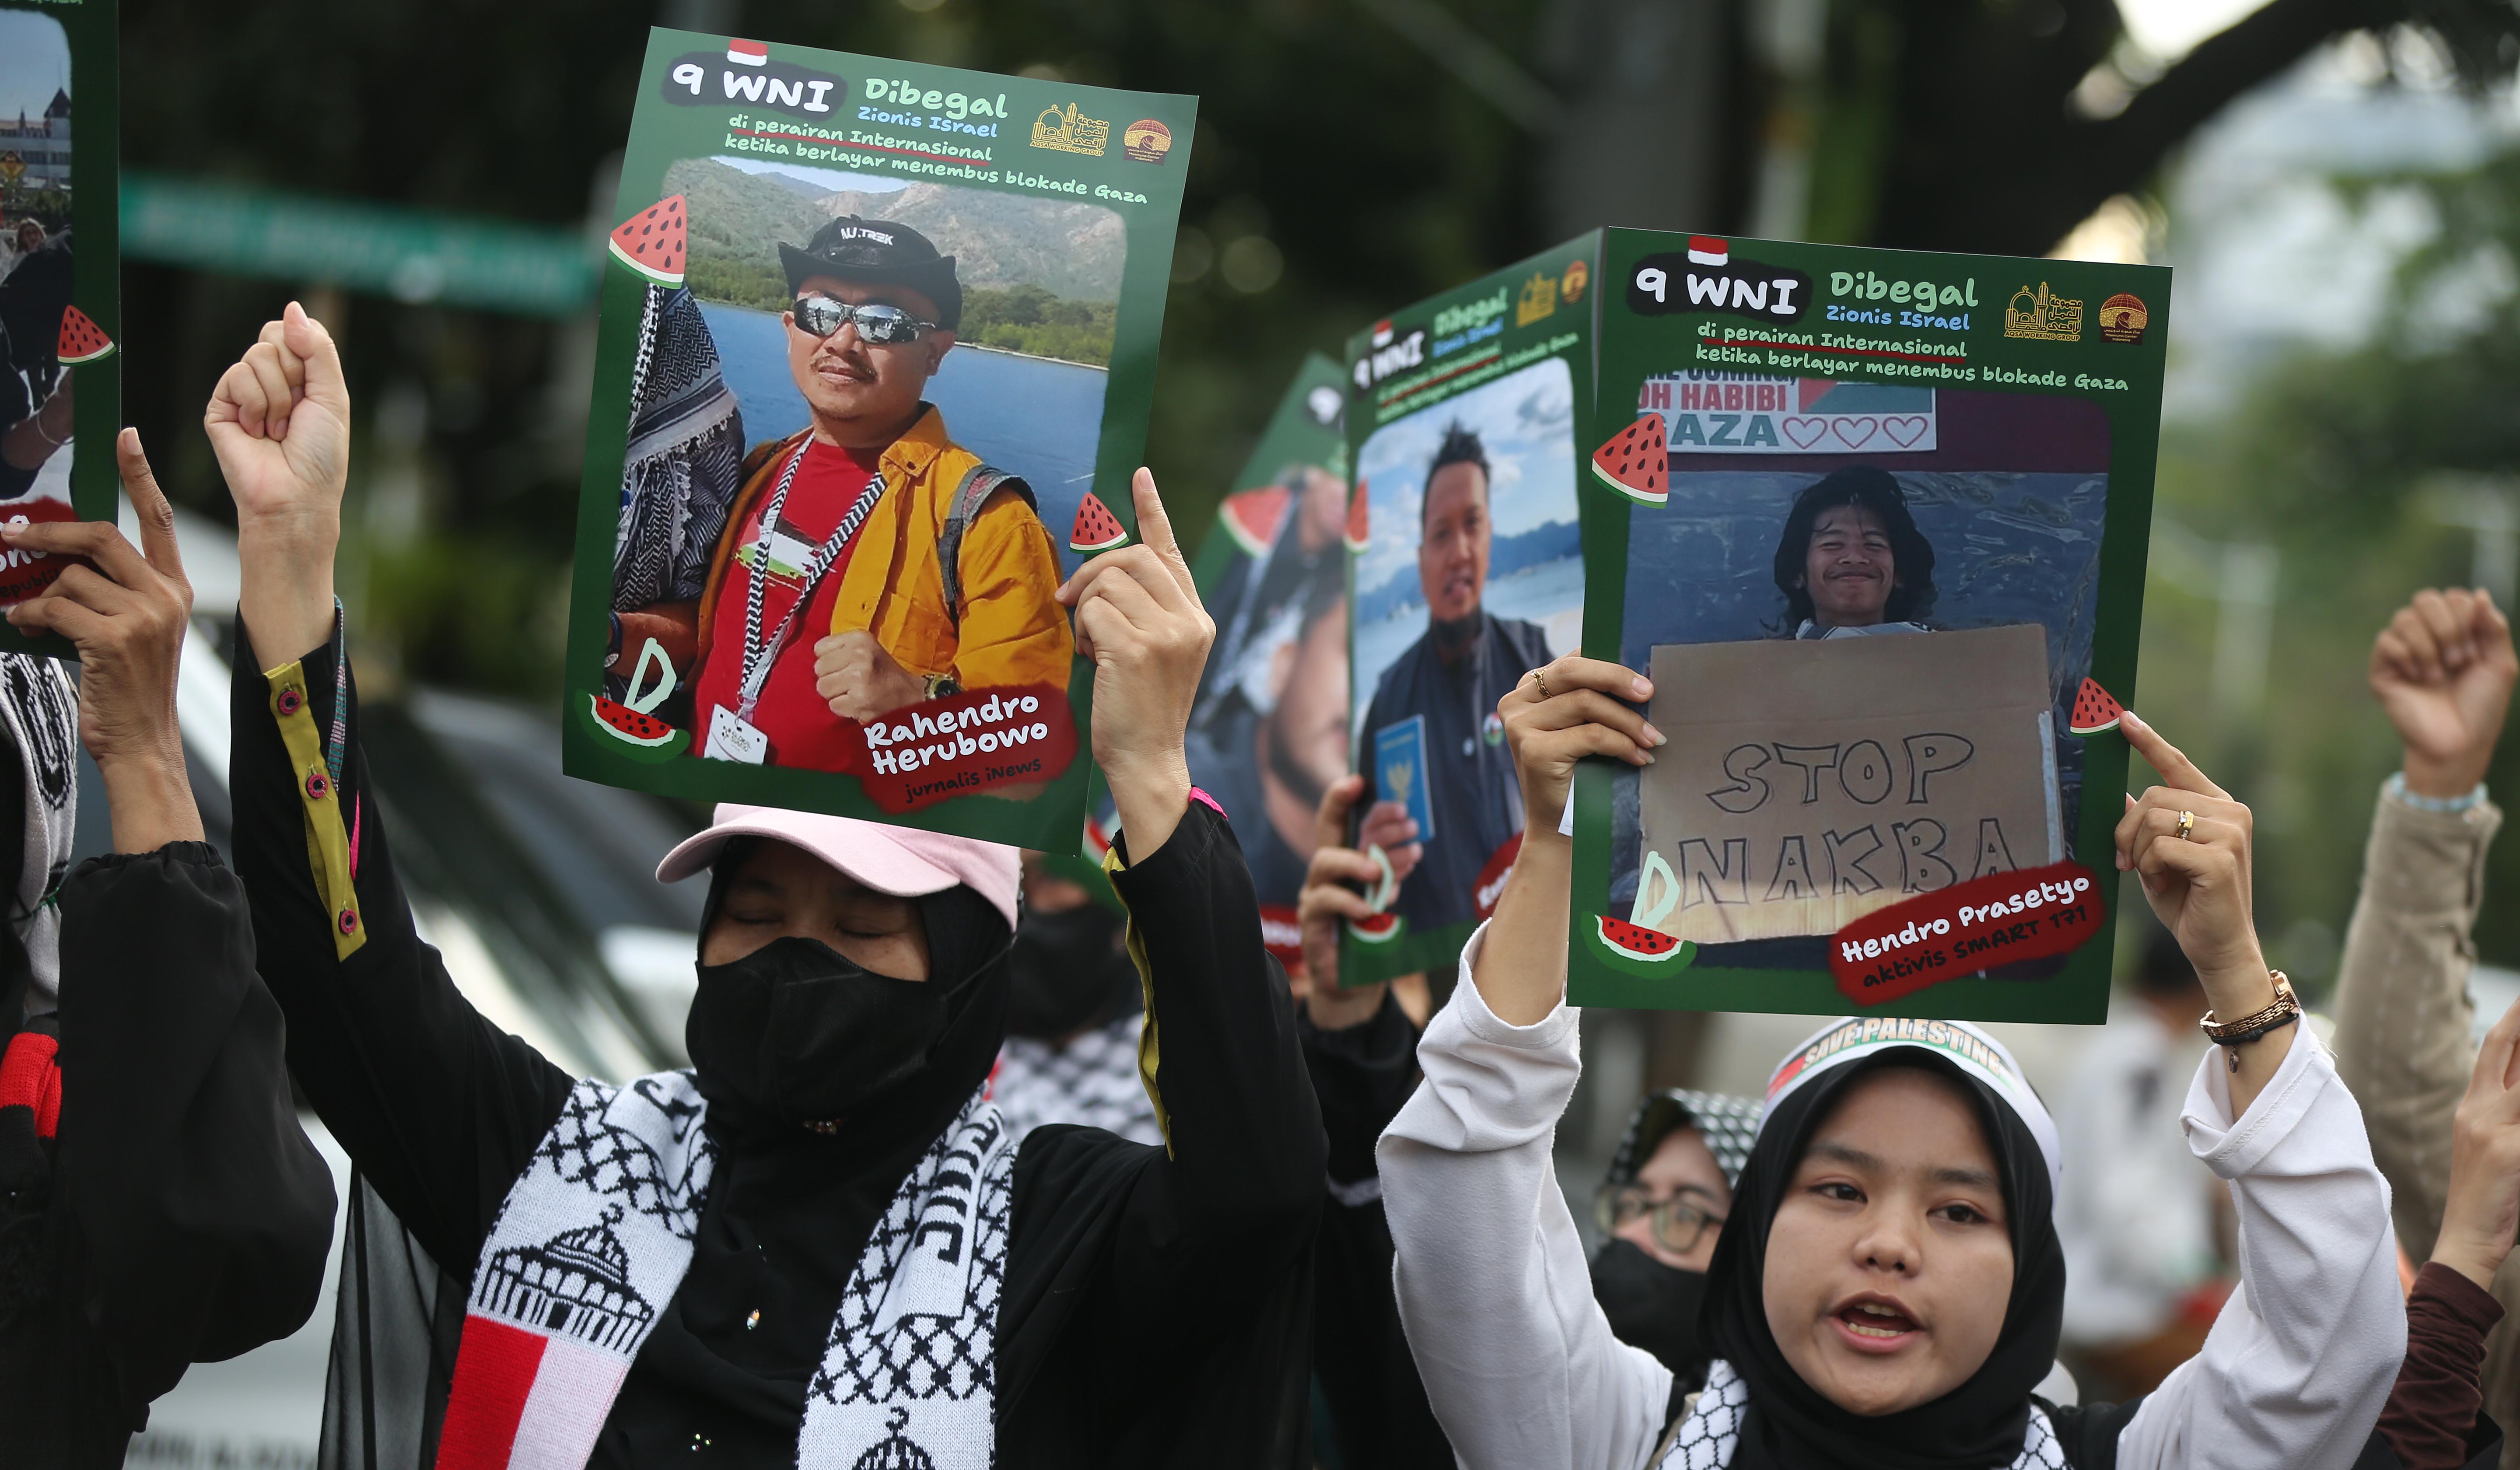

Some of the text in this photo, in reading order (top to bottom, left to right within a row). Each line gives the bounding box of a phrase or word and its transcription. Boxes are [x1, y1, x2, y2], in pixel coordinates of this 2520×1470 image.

[673, 64, 834, 112] 9 WNI
[865, 78, 1008, 120] Dibegal
[729, 114, 992, 161] di perairan Internasional
[858, 106, 998, 137] Zionis Israel
[725, 133, 1148, 204] ketika berlayar menembus blokade Gaza
[1030, 140, 1104, 157] AQSA WORKING GROUP
[1636, 268, 1799, 315] 9 WNI
[1830, 271, 1979, 313] Dibegal
[1698, 322, 1968, 357] di perairan Internasional
[1826, 305, 1970, 330] Zionis Israel
[2024, 332, 2056, 340] WORKING
[1696, 344, 2129, 391] ketika berlayar menembus blokade Gaza
[1681, 383, 1786, 412] HABIBI
[1637, 412, 1779, 446] AZA
[864, 694, 1039, 749] Rahendro
[872, 723, 1049, 775] Herubowo
[906, 758, 1042, 804] jurnalis iNews
[1706, 732, 1974, 814] STOP
[1679, 817, 2018, 911] NAKBA
[1841, 877, 2090, 963] Hendro Prasetyo
[1863, 904, 2087, 987] aktivis SMART 171
[1801, 1018, 2001, 1076] SAVE PALESTINE
